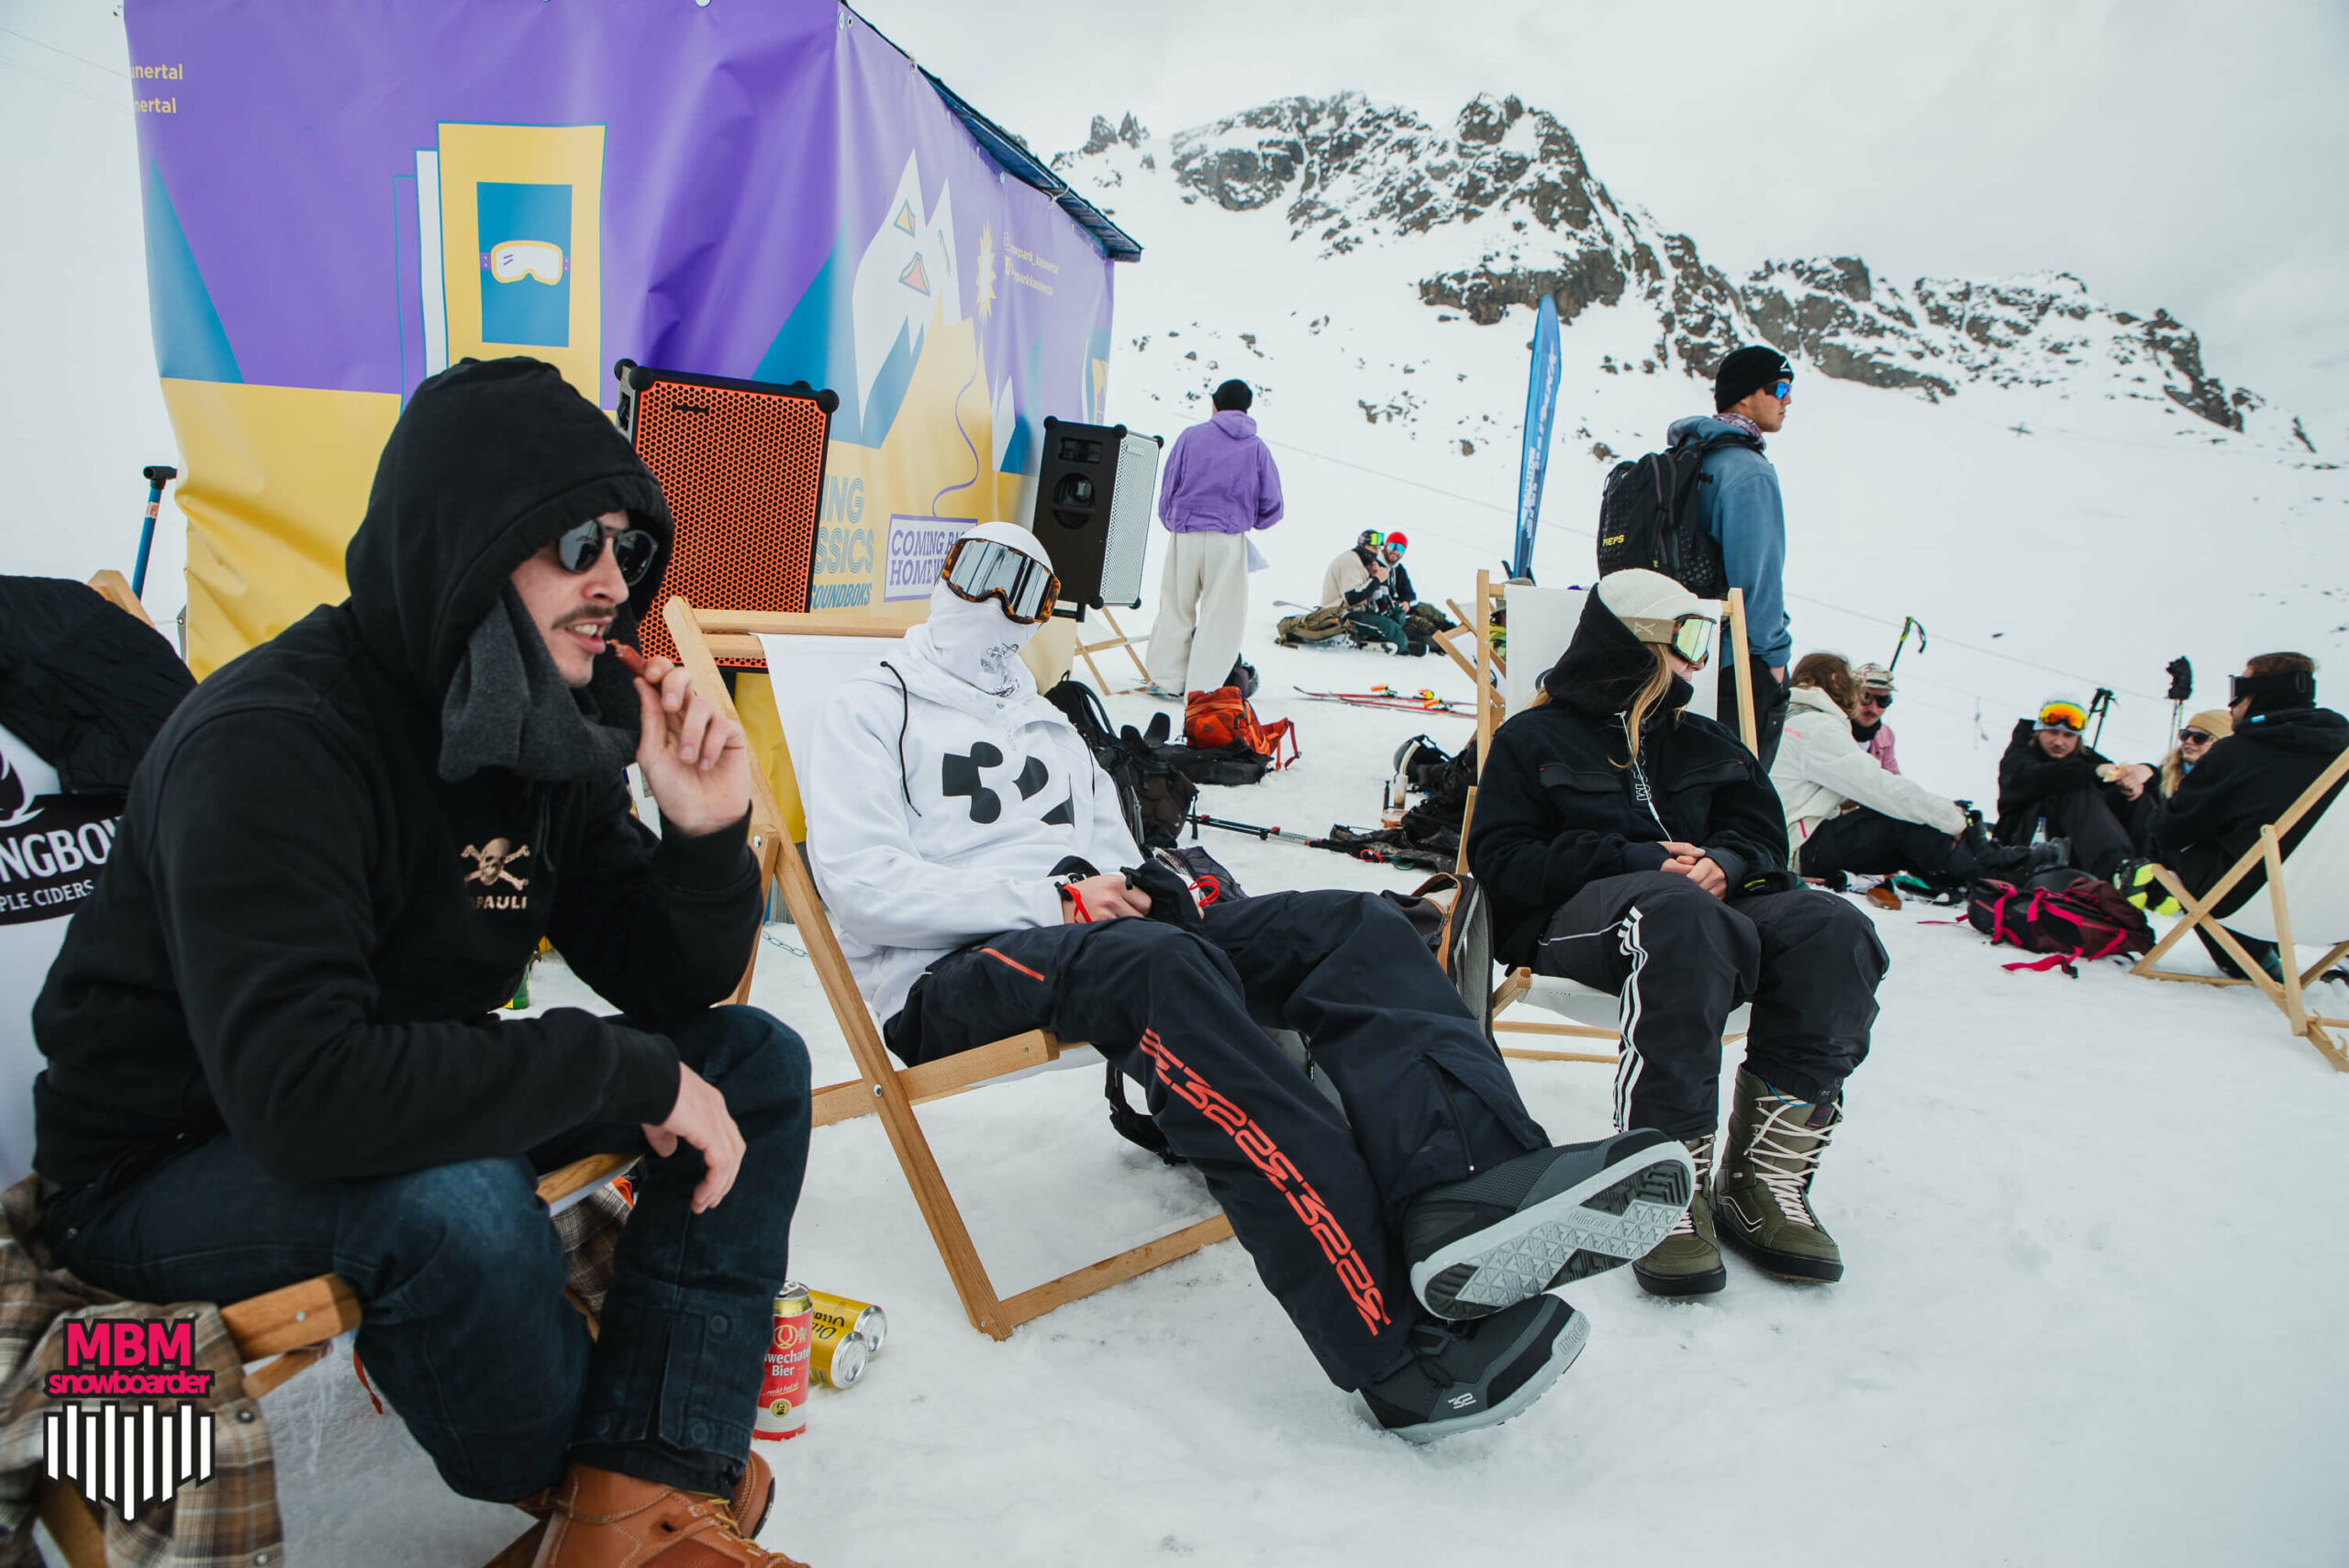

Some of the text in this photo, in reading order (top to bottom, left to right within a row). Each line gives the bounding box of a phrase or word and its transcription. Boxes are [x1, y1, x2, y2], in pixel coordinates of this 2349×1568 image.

[891, 529, 945, 556] COMING
[889, 559, 932, 586] HOME
[32, 879, 95, 906] CIDERS
[772, 1364, 796, 1377] Bier
